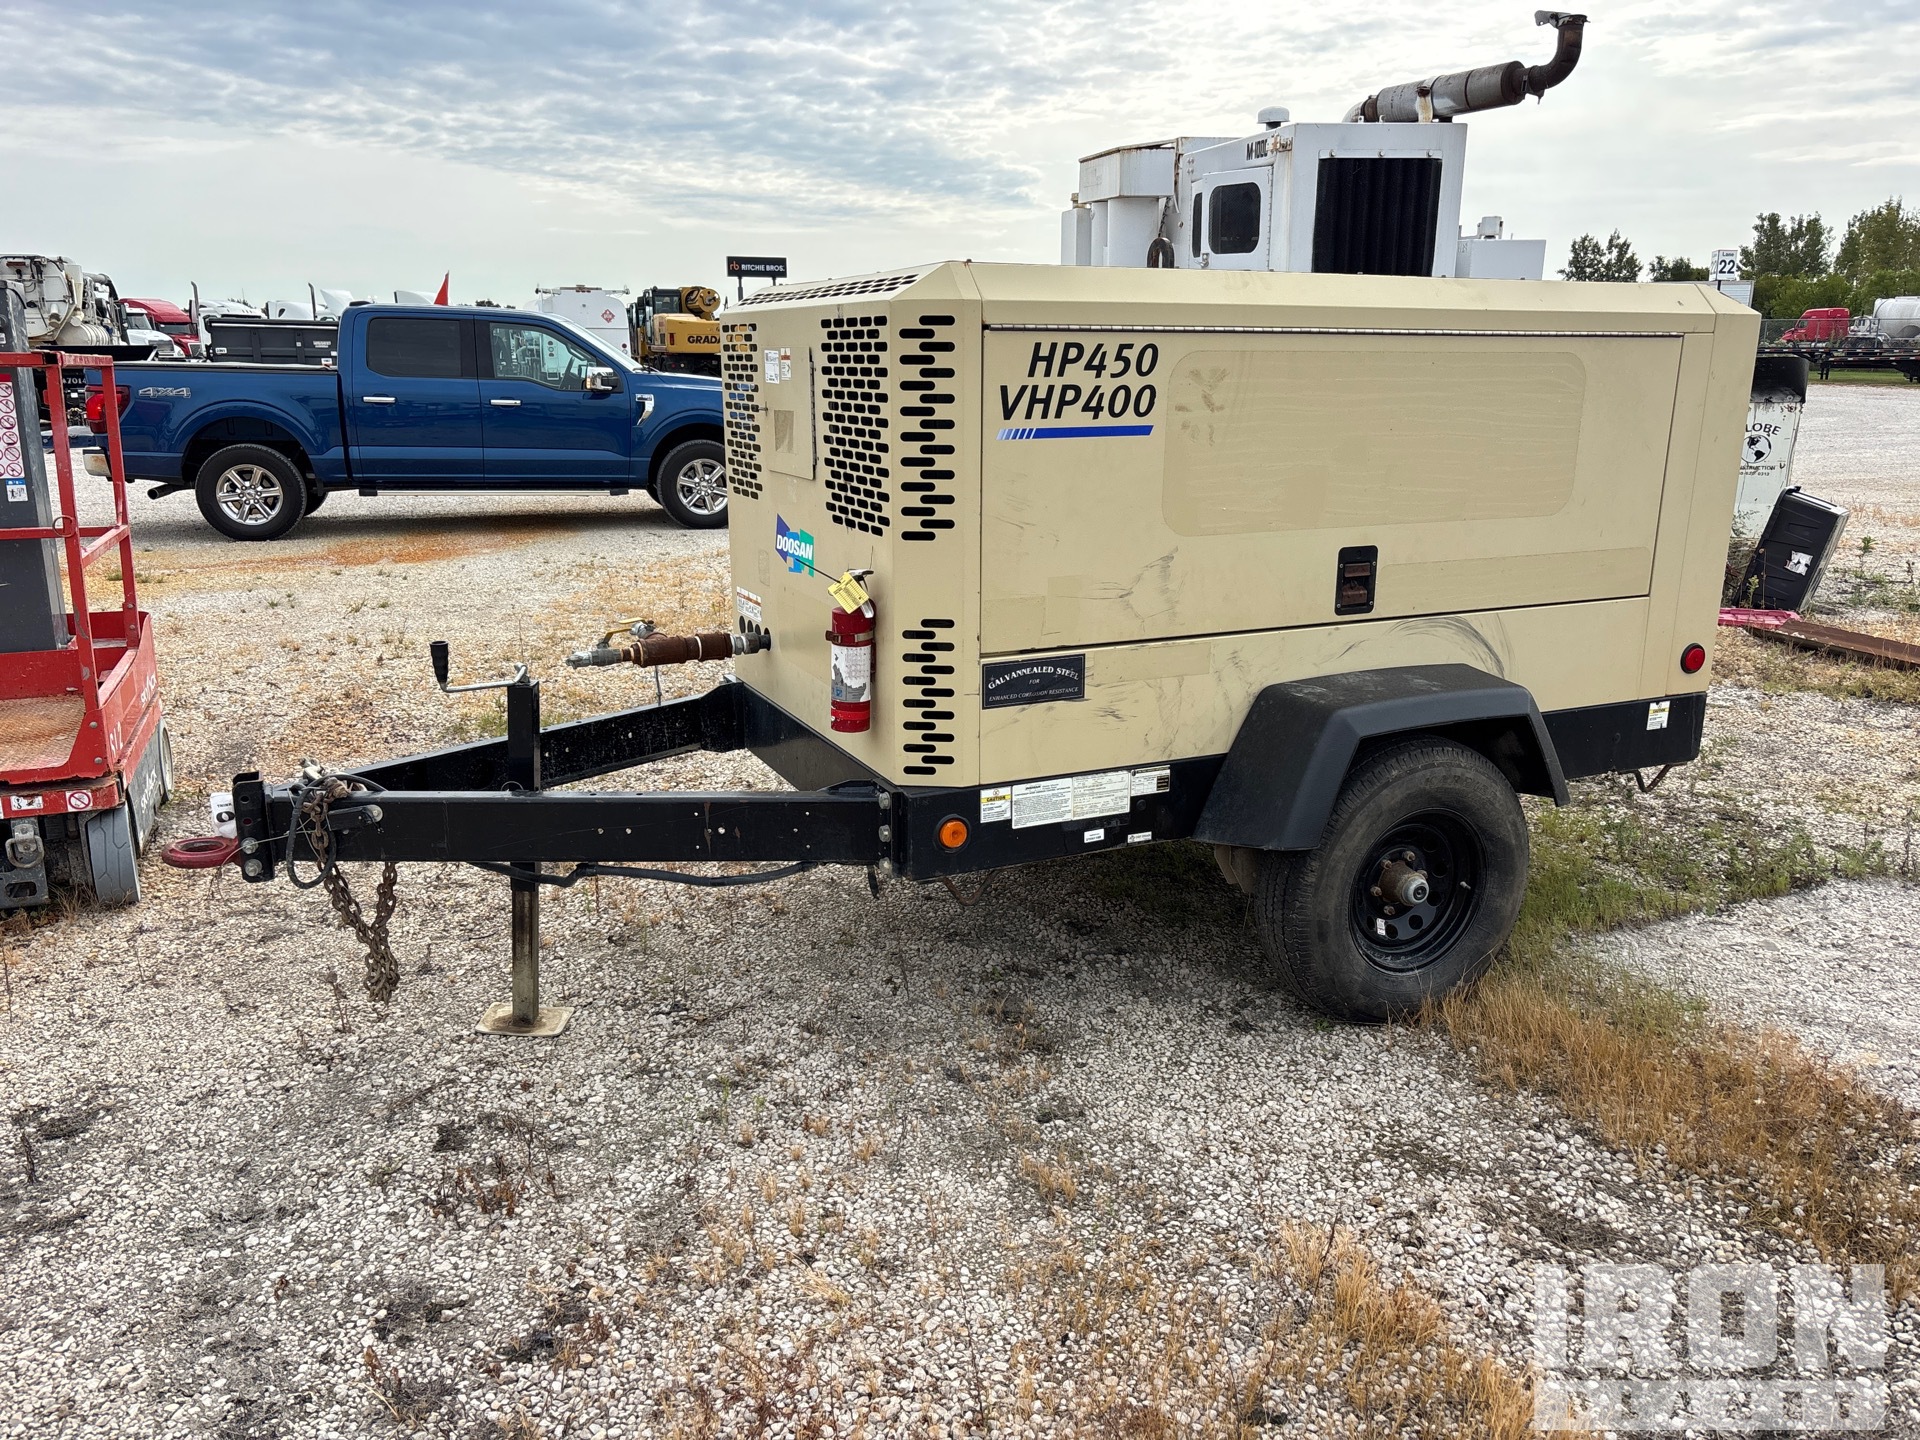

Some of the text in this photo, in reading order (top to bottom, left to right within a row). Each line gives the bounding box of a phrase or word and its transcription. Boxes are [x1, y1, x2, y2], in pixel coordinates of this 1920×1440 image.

[1719, 260, 1735, 274] 22
[1027, 342, 1159, 379] HP450
[1000, 384, 1157, 420] VHP400
[1745, 423, 1782, 435] LOBE
[776, 534, 813, 561] DOOSAN
[988, 666, 1079, 689] GALVANNEALED STEEL
[988, 693, 1018, 702] ENHANCED
[1048, 686, 1079, 695] RESISTANCE
